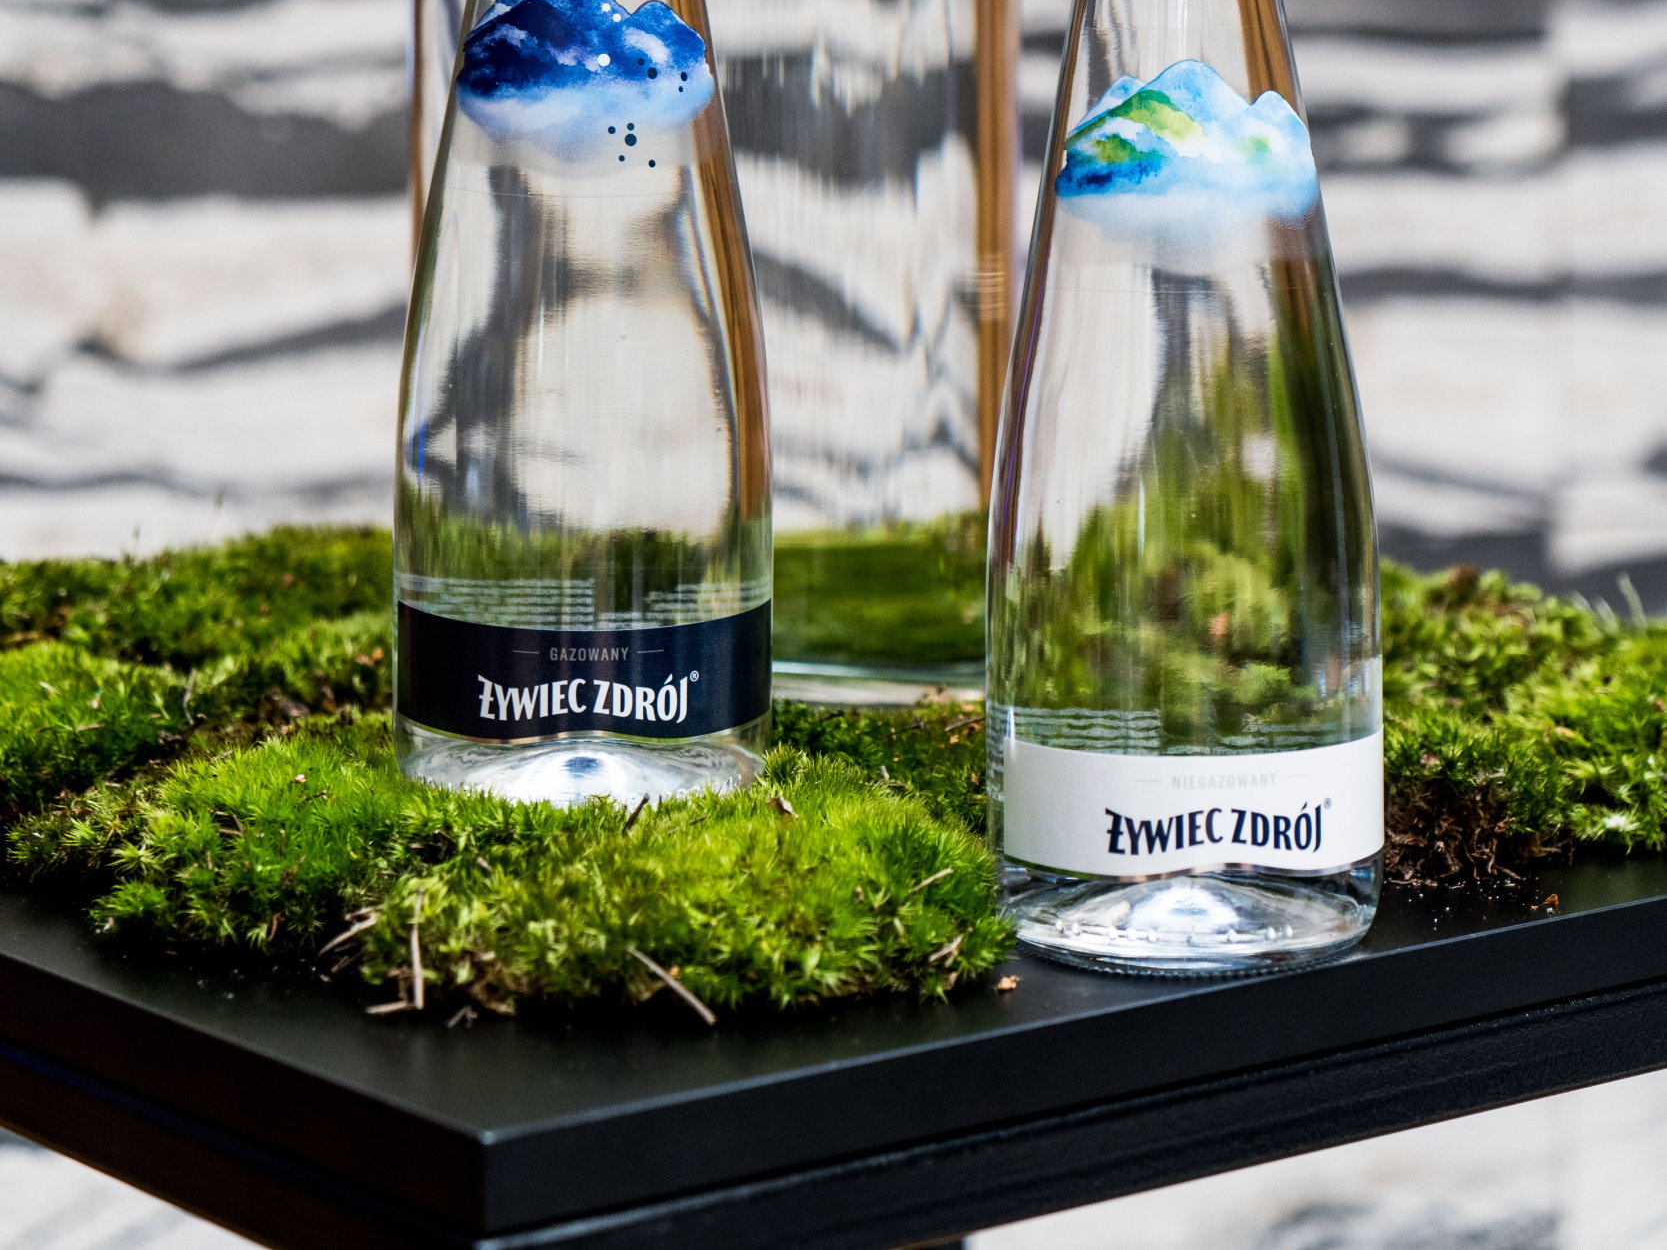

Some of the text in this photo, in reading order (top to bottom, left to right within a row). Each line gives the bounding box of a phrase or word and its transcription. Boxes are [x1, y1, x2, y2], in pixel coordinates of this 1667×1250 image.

[549, 646, 630, 662] GAZOWANY
[477, 673, 587, 722] ŻYWIEC
[1171, 772, 1278, 790] NIEGAZOWANY
[1104, 807, 1224, 856] ŻYWIEC
